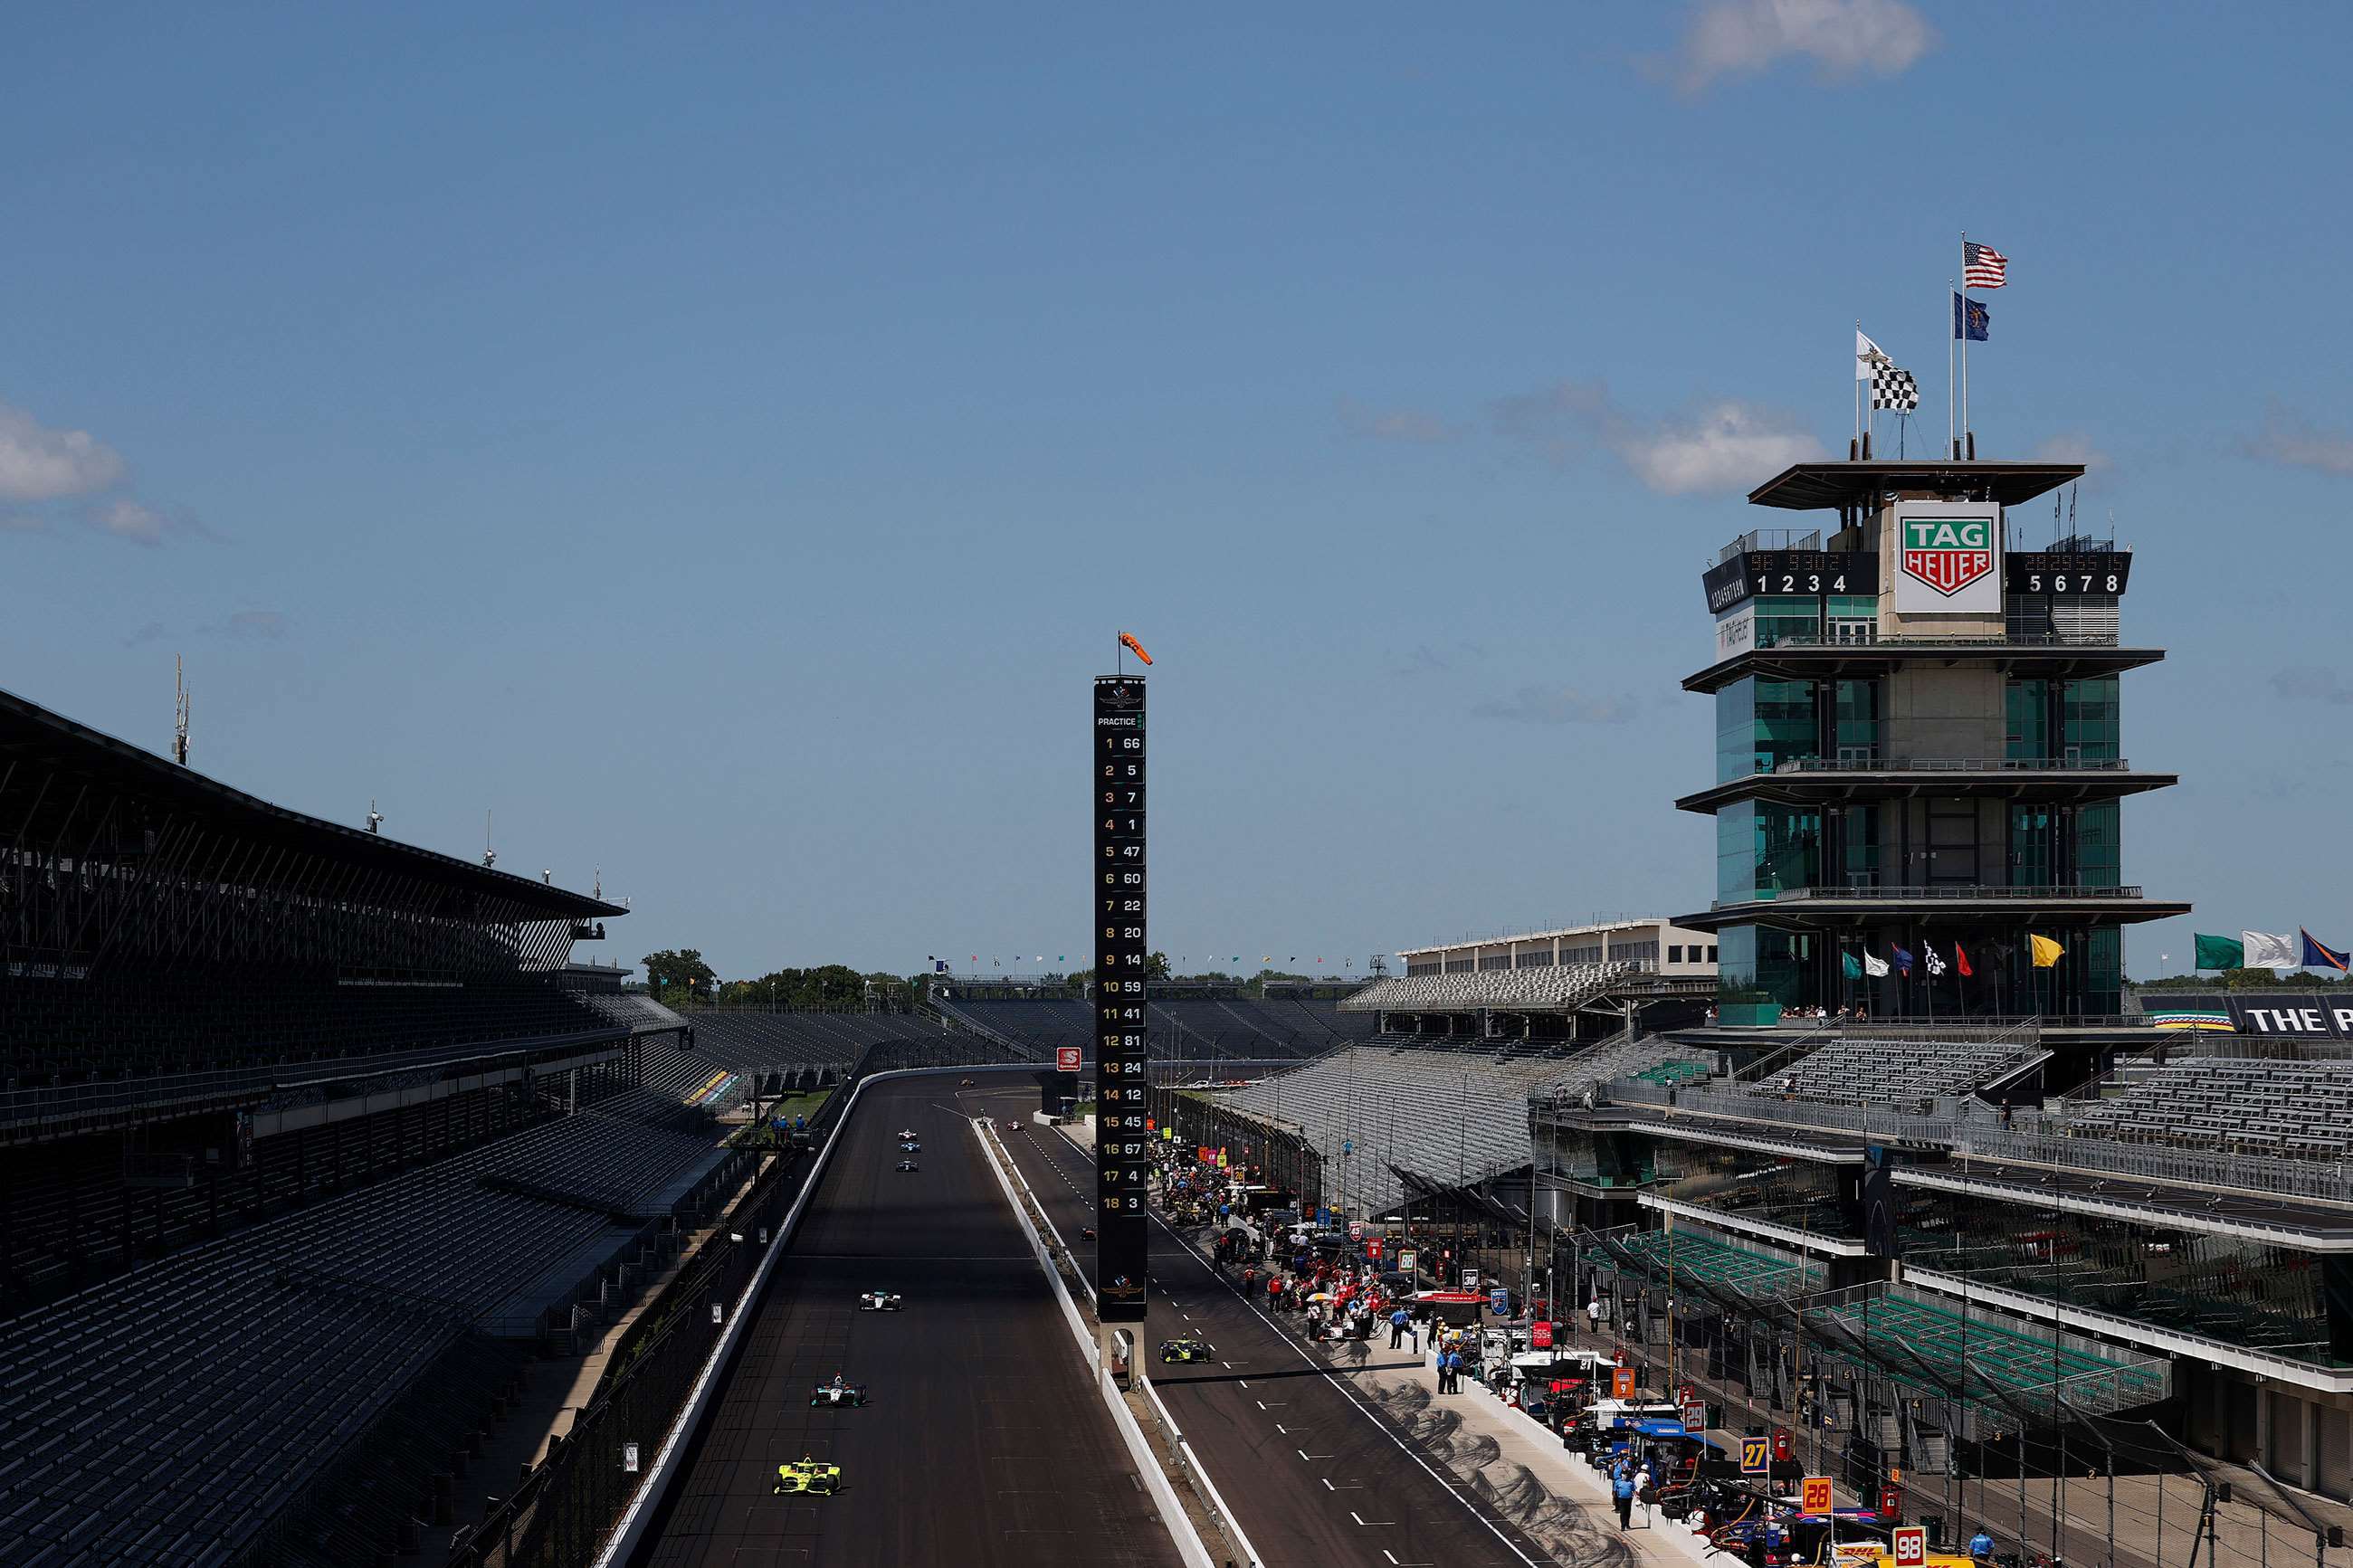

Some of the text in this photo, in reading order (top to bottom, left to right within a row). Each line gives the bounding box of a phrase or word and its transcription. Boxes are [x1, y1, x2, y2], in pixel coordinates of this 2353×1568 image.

[1910, 524, 1983, 546] TAG
[1908, 553, 1986, 589] HEUER
[1758, 575, 1846, 593] 1 2 3 4
[2030, 575, 2118, 592] 5 6 7 8
[1098, 717, 1136, 726] PRACTICE
[1106, 737, 1140, 749] 1 66
[1105, 765, 1137, 776] 2 5
[1105, 792, 1136, 803] 3 7
[1105, 819, 1135, 831] 4 1
[1105, 846, 1140, 857] 5 47
[1106, 873, 1141, 884] 6 60
[1106, 900, 1140, 911] 7 22
[1106, 927, 1141, 938] 8 20
[1106, 954, 1141, 965] 9 14
[1103, 981, 1141, 993] 10 59
[1103, 1008, 1140, 1020] 11 41
[2245, 1009, 2327, 1031] THE
[1103, 1035, 1140, 1046] 12 81
[1103, 1062, 1141, 1073] 13 24
[1103, 1088, 1141, 1100] 14 12
[1103, 1116, 1141, 1127] 15 45
[1103, 1144, 1141, 1155] 16 67
[1103, 1170, 1138, 1182] 17 4
[1103, 1197, 1138, 1209] 18 3
[1464, 1276, 1476, 1285] 30
[1621, 1383, 1626, 1393] 9
[1912, 1399, 1920, 1408] 4
[1686, 1406, 1702, 1428] 29
[1994, 1432, 2002, 1441] 3
[1744, 1444, 1766, 1467] 27
[2088, 1469, 2095, 1478] 2
[1805, 1484, 1828, 1508] 28
[2204, 1516, 2210, 1525] 1
[1898, 1535, 1921, 1560] 98
